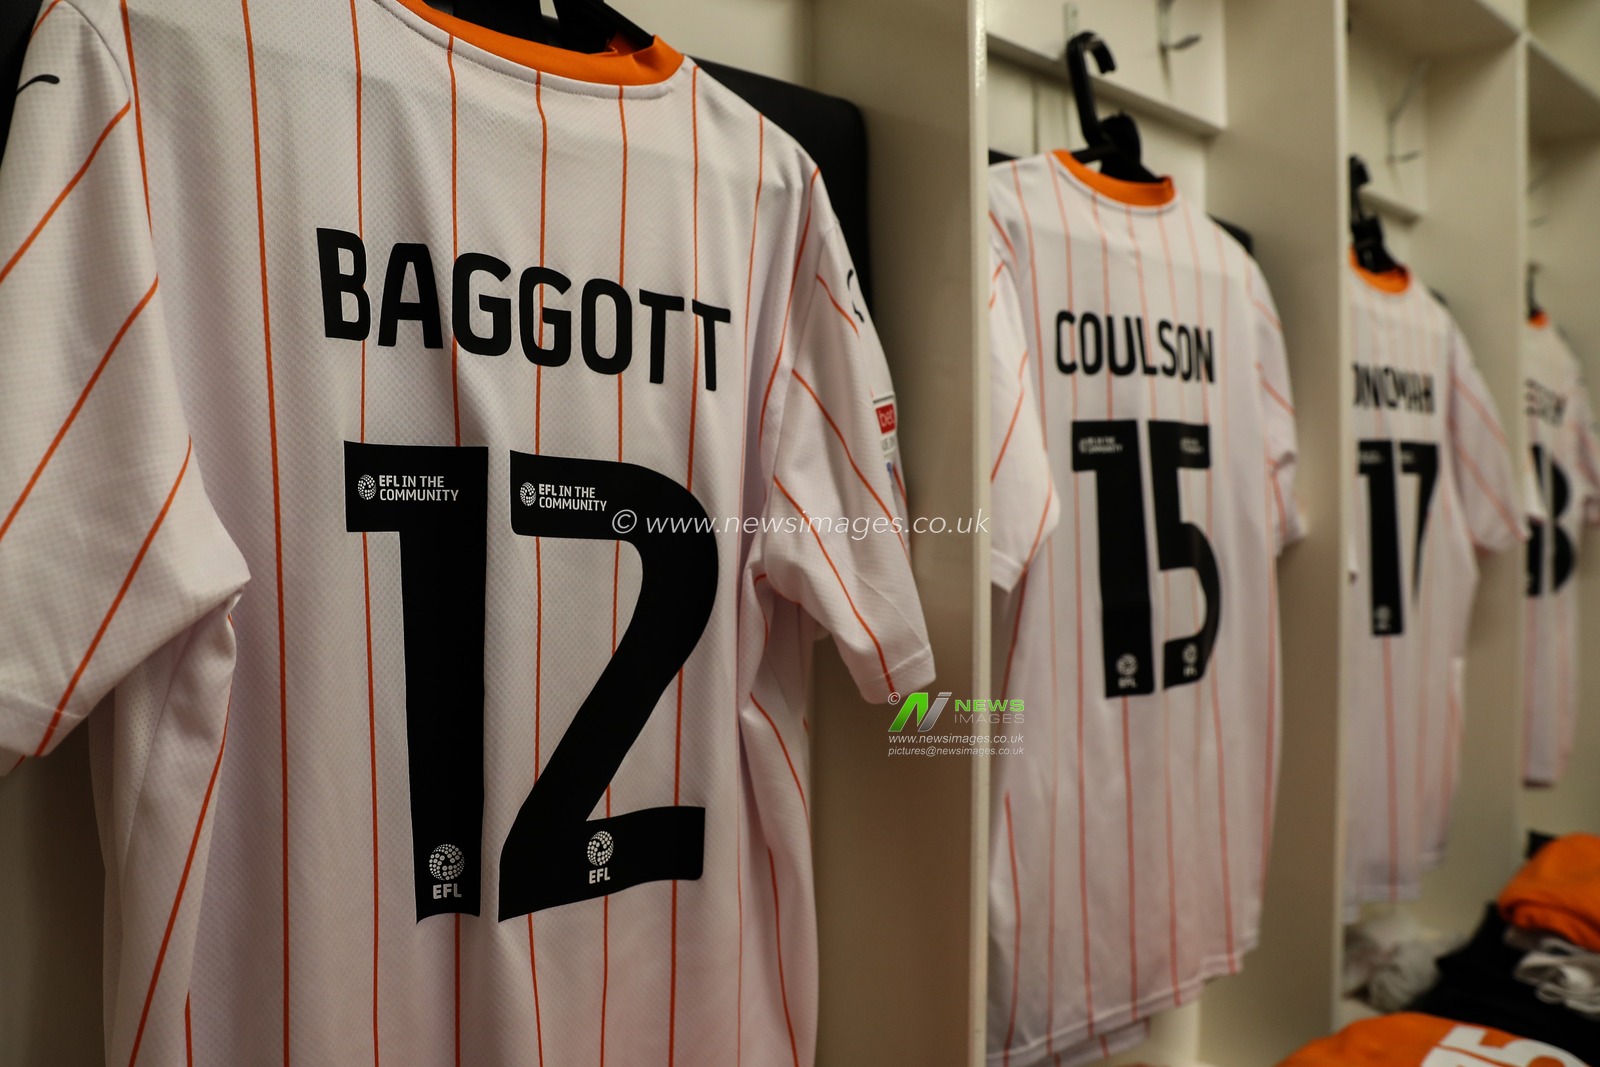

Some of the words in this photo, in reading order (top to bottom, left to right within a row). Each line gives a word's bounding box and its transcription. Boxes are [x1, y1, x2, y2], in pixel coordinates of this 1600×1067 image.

[316, 228, 731, 392] BAGGOTT
[1056, 310, 1215, 384] COULSON
[379, 475, 400, 487] EFL
[402, 475, 416, 488] IN
[420, 475, 444, 488] THE
[379, 488, 459, 501] COMMUNITY
[539, 483, 557, 496] EFL
[559, 485, 572, 497] IN
[574, 486, 596, 499] THE
[539, 496, 607, 512] COMMUNITY
[1358, 440, 1439, 636] 17
[1072, 419, 1221, 699] 15
[344, 440, 718, 924] 12
[588, 867, 611, 885] EFL
[432, 883, 462, 900] EFL
